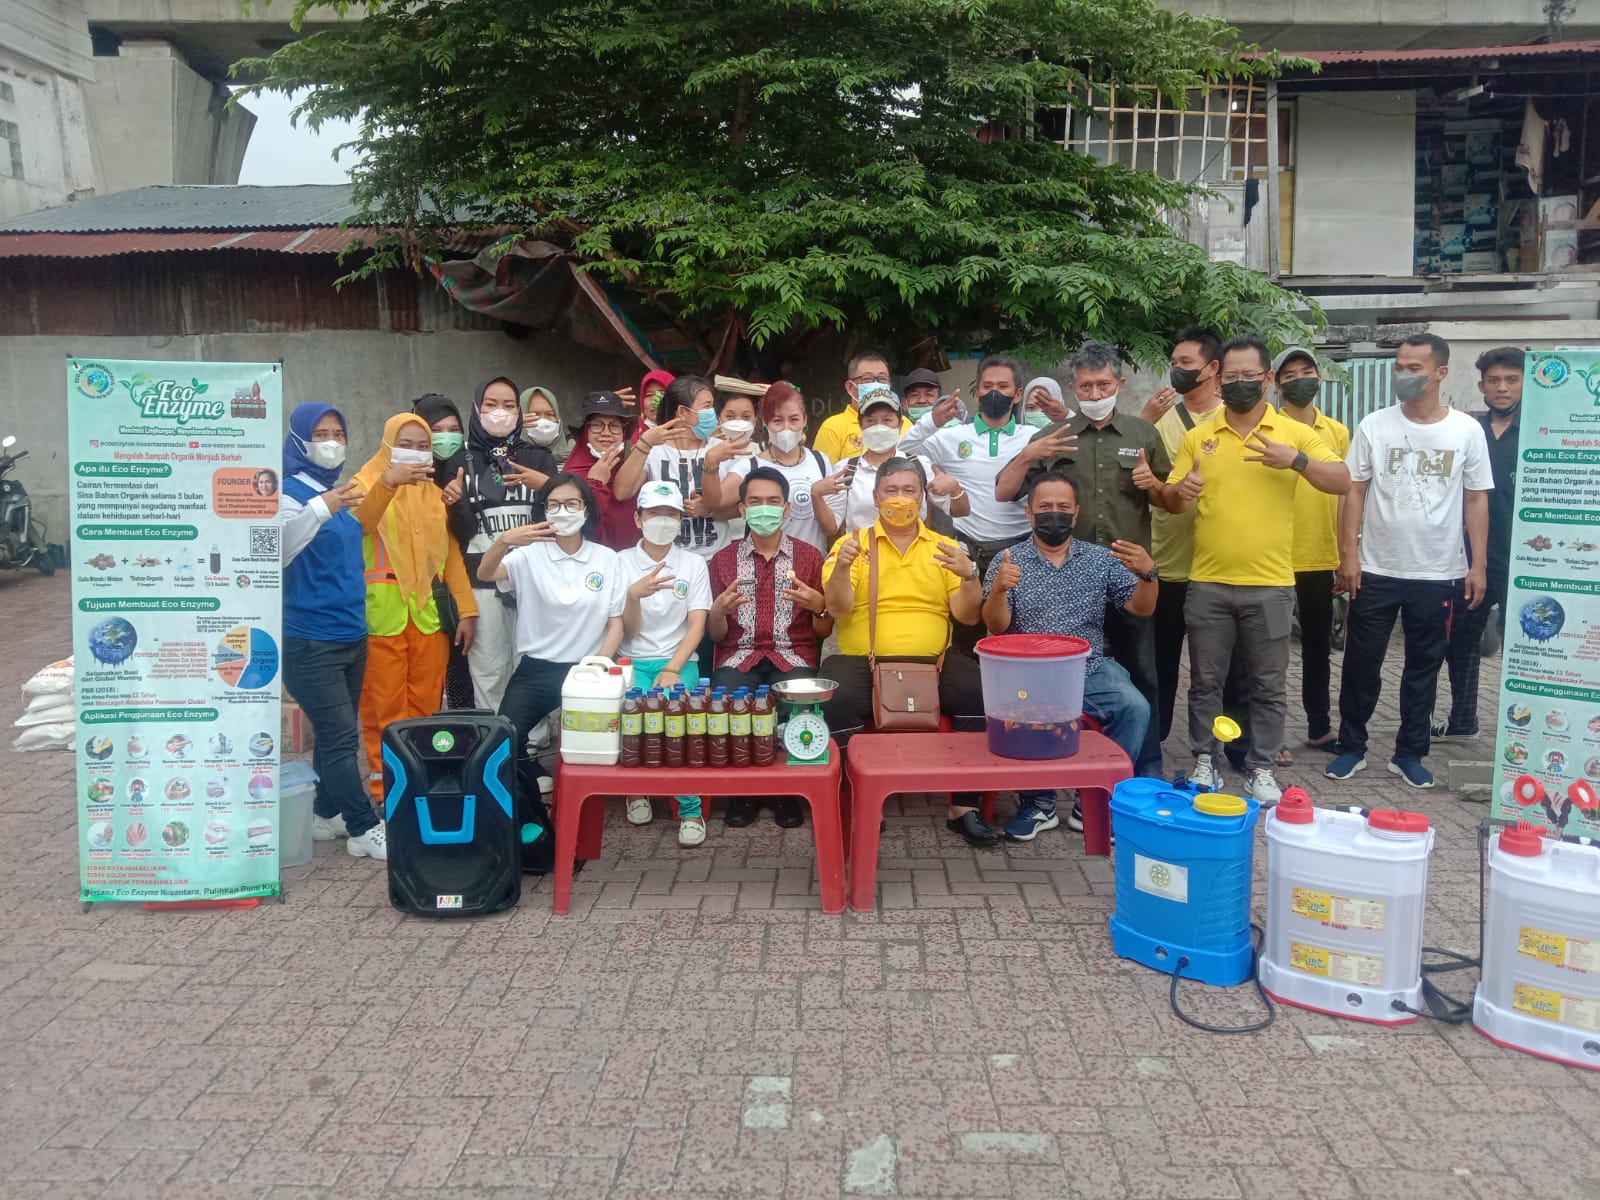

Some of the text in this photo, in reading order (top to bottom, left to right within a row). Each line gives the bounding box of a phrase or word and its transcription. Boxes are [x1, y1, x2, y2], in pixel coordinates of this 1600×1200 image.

[157, 380, 197, 402] Eco
[141, 394, 224, 422] Enzyme
[1526, 451, 1544, 460] Apa
[1545, 451, 1557, 459] itu
[79, 465, 97, 475] Apa
[99, 465, 110, 473] itu
[130, 466, 169, 475] Enzyme?
[1523, 466, 1588, 475] Cairan fermentasi
[76, 480, 159, 490] Cairan fermentasi dari
[217, 478, 251, 486] FOUNDER
[1522, 476, 1538, 484] Sisa
[1563, 477, 1594, 486] Organik
[76, 491, 94, 499] Sisa
[94, 491, 119, 499] Bahan
[120, 491, 149, 501] Organik
[150, 492, 176, 500] selama
[183, 492, 204, 500] bulan
[1521, 487, 1539, 495] yang
[1540, 487, 1583, 497] mempunyai
[1543, 496, 1582, 505] kehidupan
[76, 502, 207, 511] yang mempunyai segudang manfaat
[76, 512, 181, 520] dalam kehidupan sehari-hari
[1523, 510, 1543, 519] Cara
[1544, 511, 1583, 521] Membuat
[81, 528, 194, 538] Cara Membuat Eco Enzyme
[1519, 578, 1593, 592] Tujuan Membuat
[85, 600, 215, 610] Tujuan Membuat Eco Enzyme
[1514, 643, 1547, 652] Selamatkan
[1521, 649, 1540, 657] Global
[1520, 658, 1539, 667] (2018)
[1508, 681, 1590, 698] Aplikasi Penggunaan
[84, 712, 117, 721] Aplikasi
[118, 711, 166, 720] Penggunaan
[183, 711, 215, 719] Enzyme
[131, 888, 159, 897] Enzyme
[160, 888, 202, 897] Nusantara,
[203, 886, 239, 895] Pulihkan
[239, 884, 261, 892] Bumi
